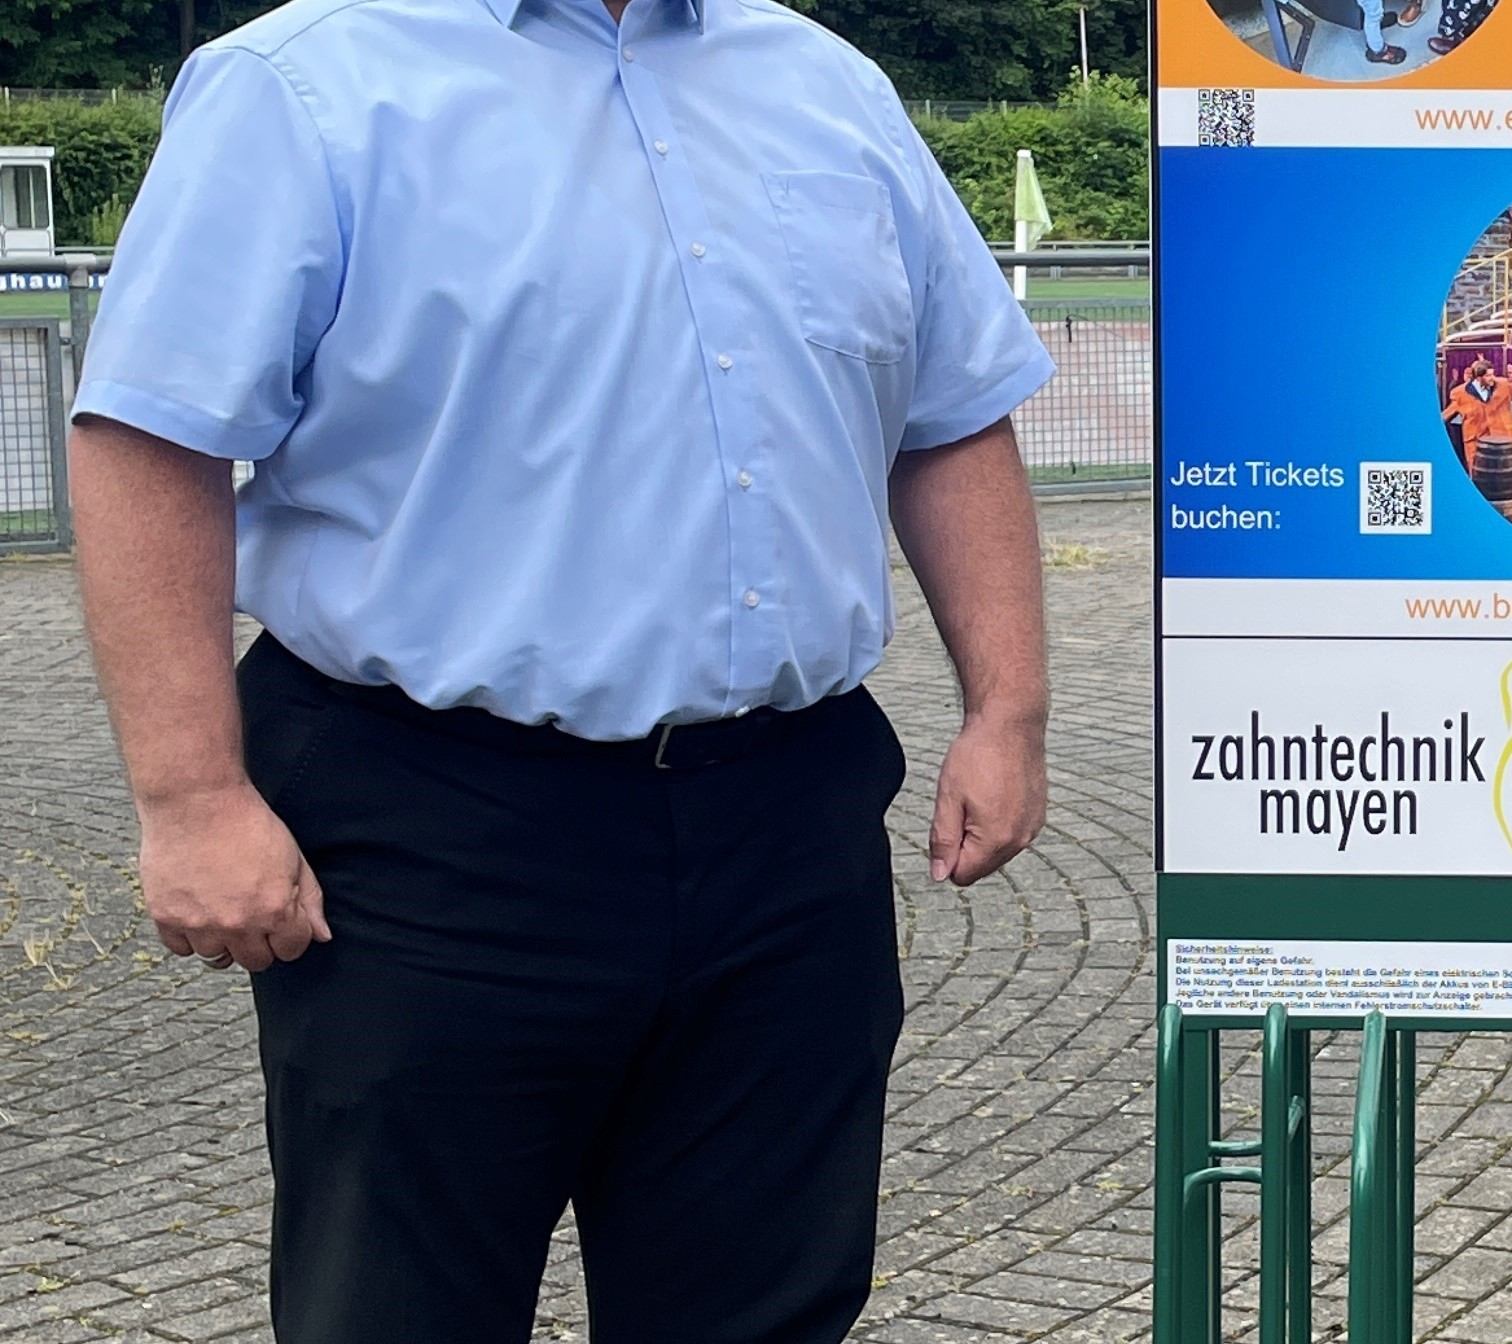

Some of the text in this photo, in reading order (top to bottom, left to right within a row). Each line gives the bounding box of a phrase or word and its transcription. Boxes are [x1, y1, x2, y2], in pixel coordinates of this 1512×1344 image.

[1169, 462, 1345, 487] Jetzt Tickets
[1171, 504, 1282, 529] buchen:
[1192, 710, 1486, 782] zahntechnik
[1260, 786, 1418, 851] mayen
